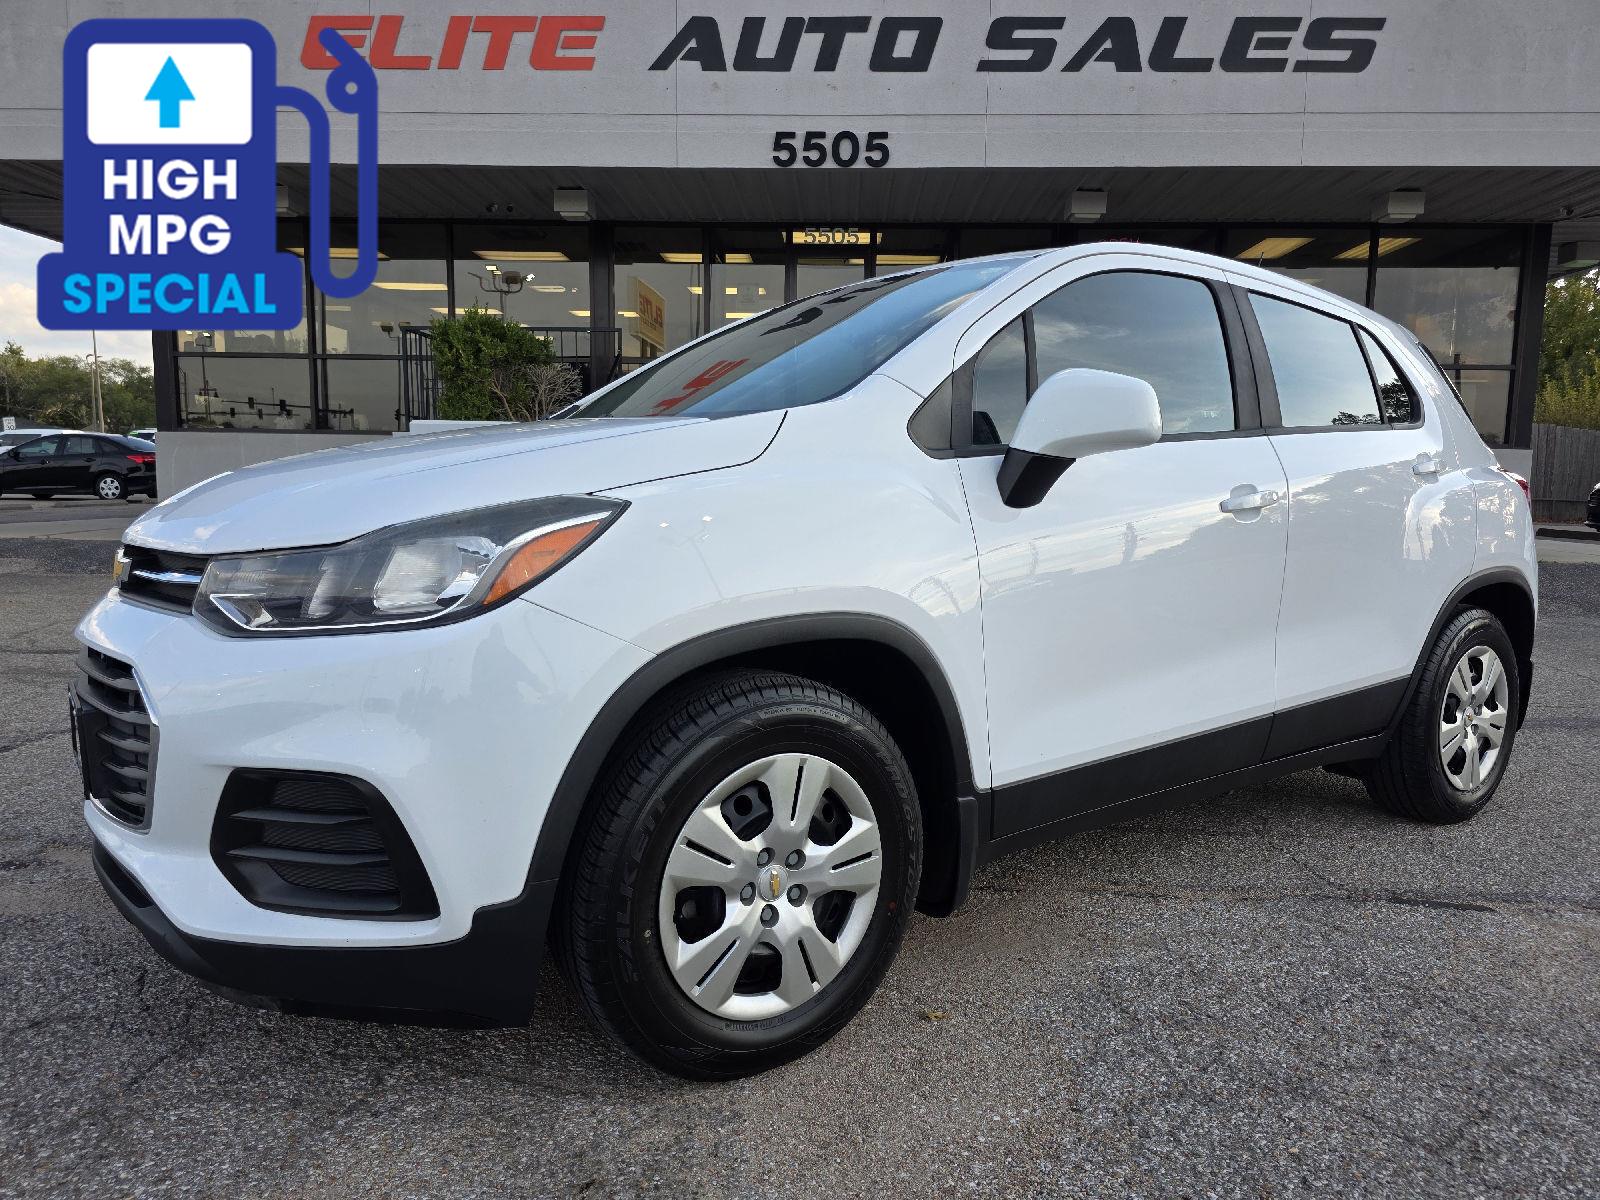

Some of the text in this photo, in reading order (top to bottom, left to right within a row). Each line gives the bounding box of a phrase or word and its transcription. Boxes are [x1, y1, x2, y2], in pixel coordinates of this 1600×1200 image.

[301, 15, 1387, 74] ELITE AUTO SALES
[772, 130, 890, 170] 5505
[803, 227, 860, 245] 5505
